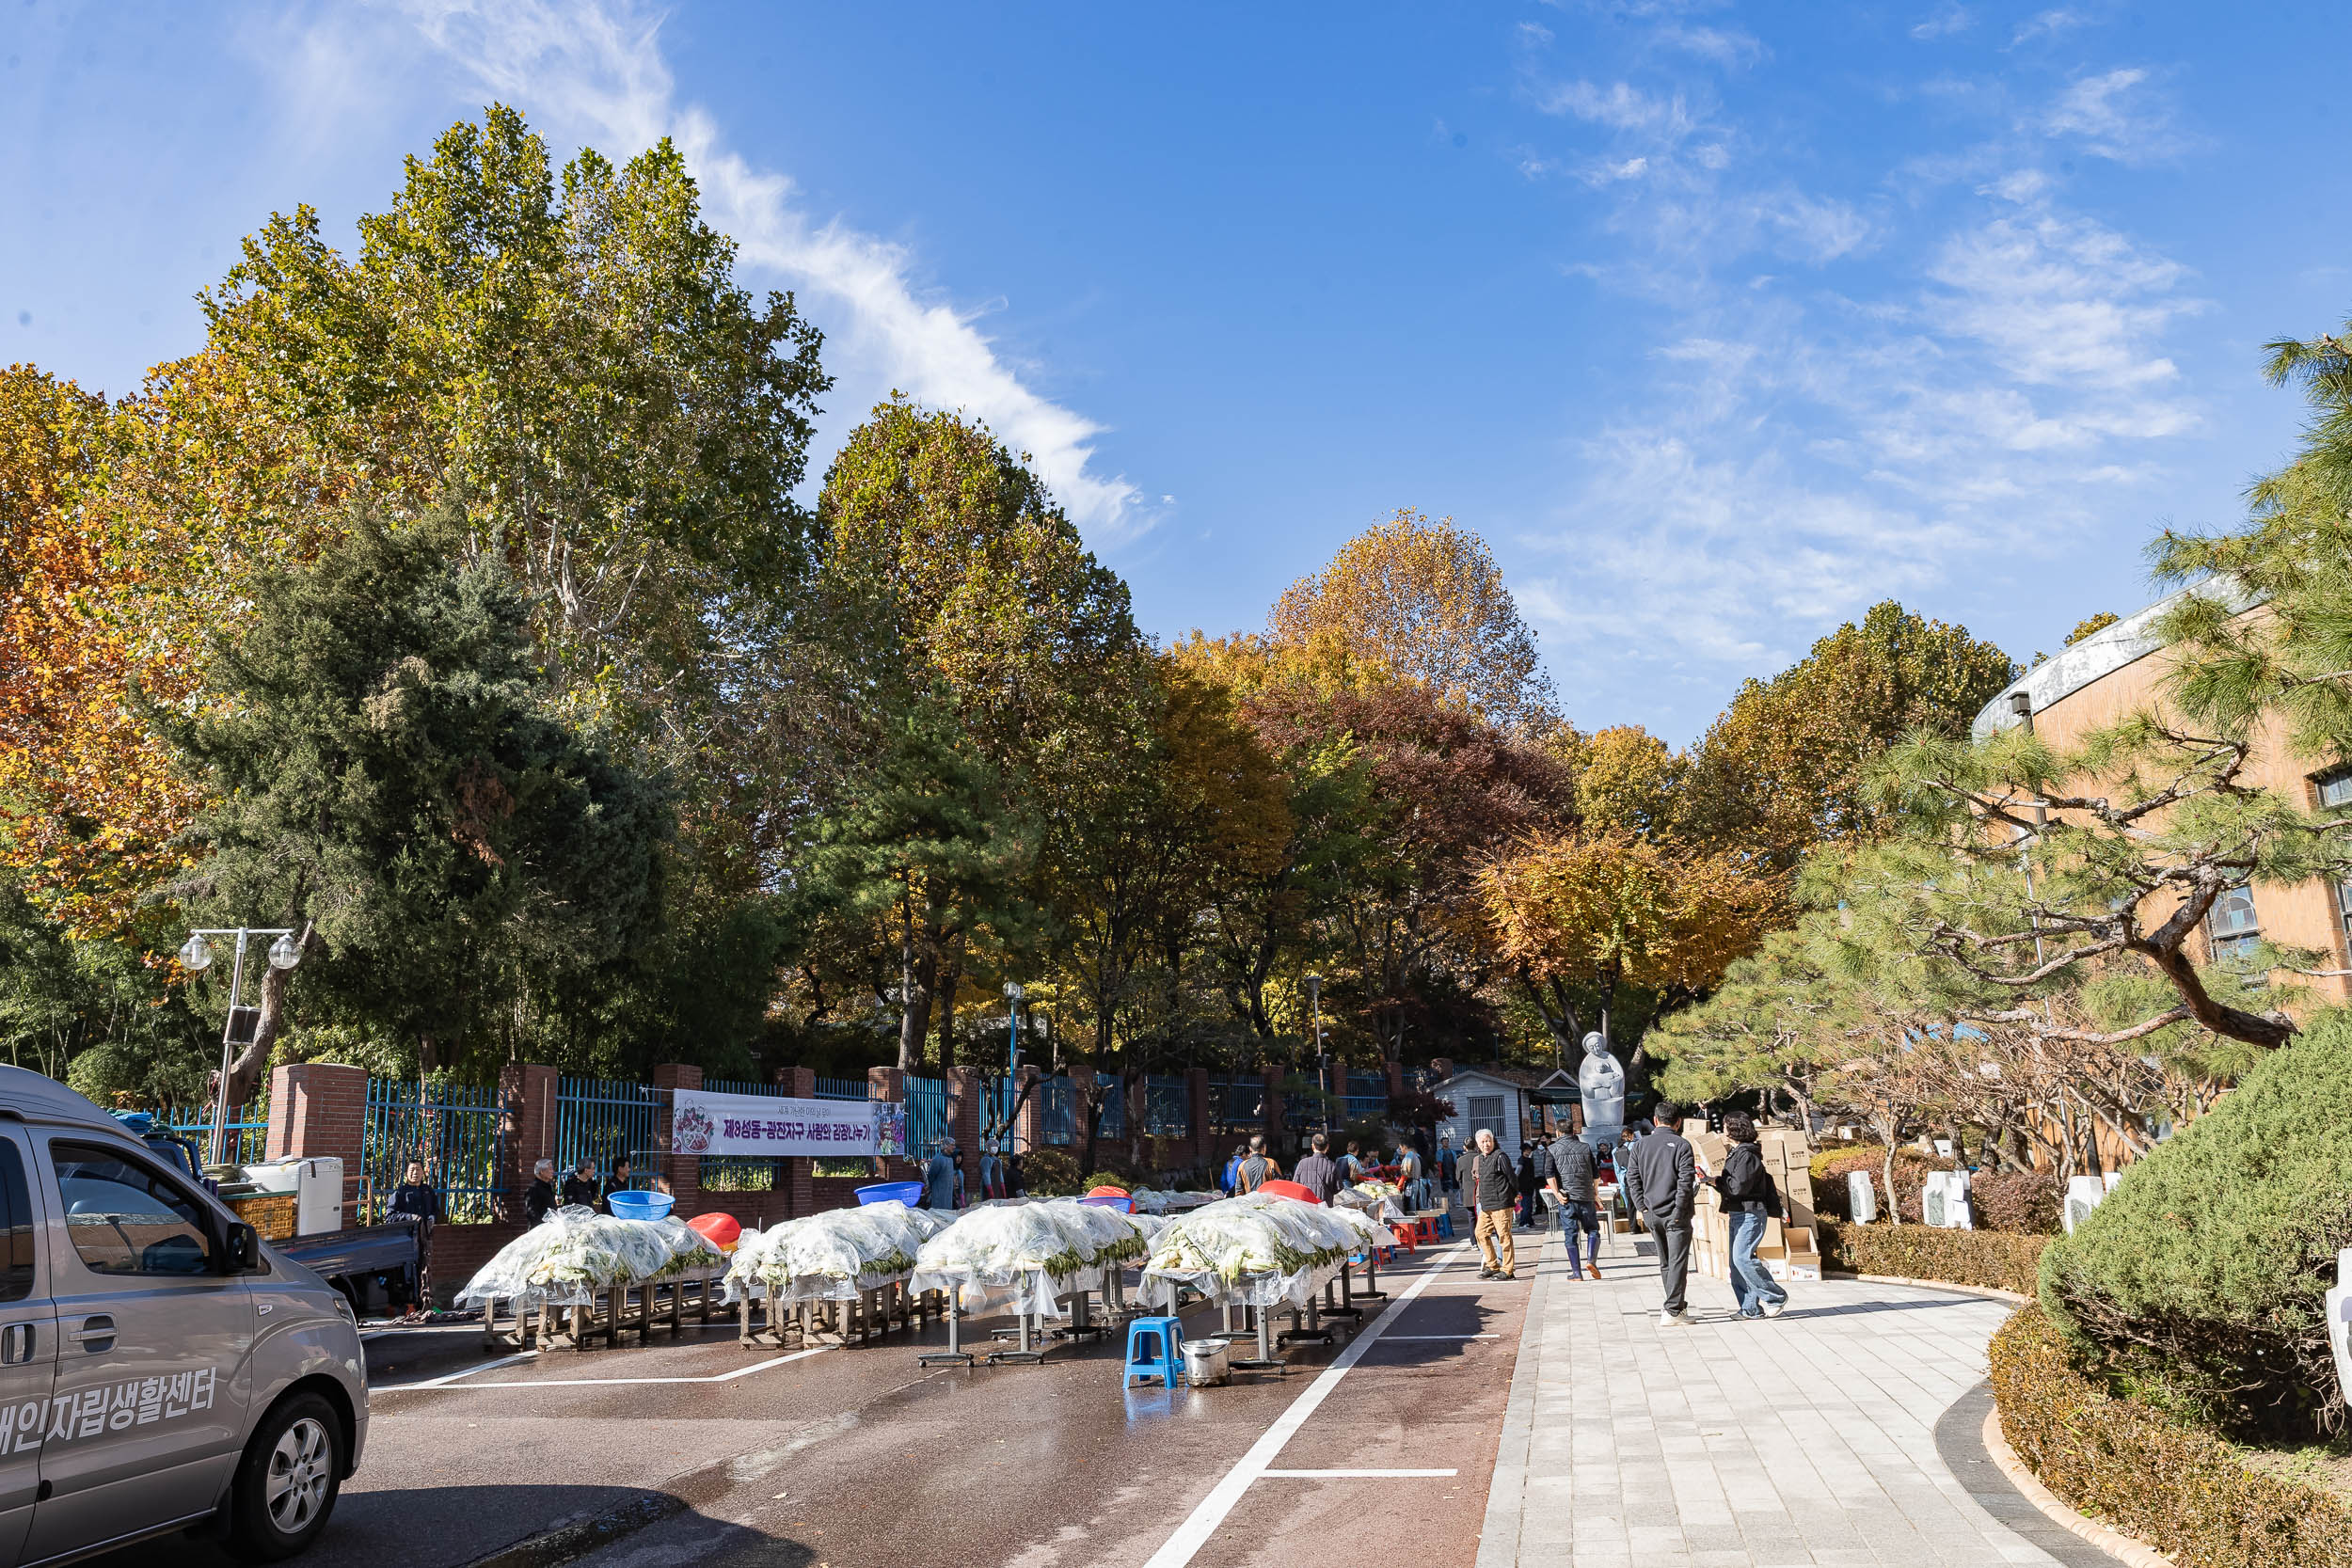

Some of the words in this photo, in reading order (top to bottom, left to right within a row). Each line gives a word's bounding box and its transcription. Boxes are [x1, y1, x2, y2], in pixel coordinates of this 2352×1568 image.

[723, 1119, 804, 1140] 제8성동-광진지구
[806, 1122, 831, 1141] 사랑의
[833, 1123, 871, 1141] 김장나누기
